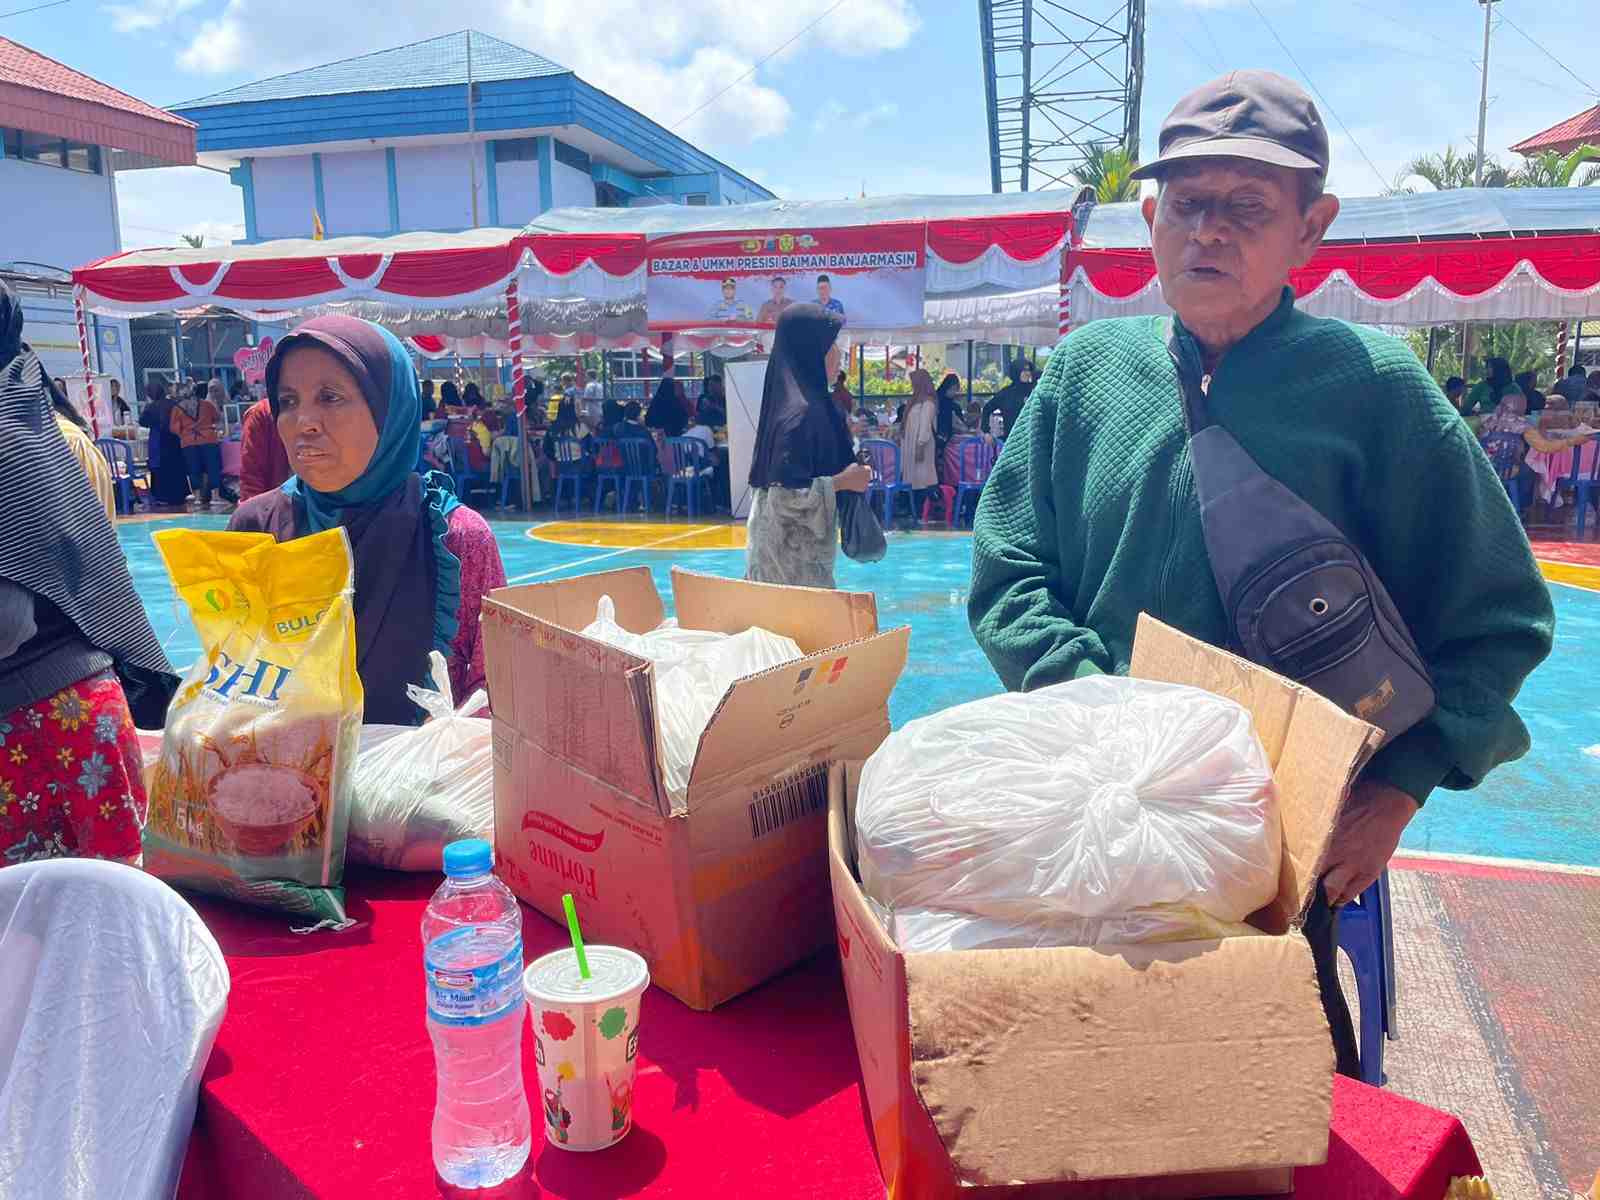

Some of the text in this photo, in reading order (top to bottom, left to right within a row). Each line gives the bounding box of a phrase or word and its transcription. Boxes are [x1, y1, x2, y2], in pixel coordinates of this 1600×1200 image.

[653, 252, 915, 271] BAZAR & UMKM PRESISI BAIMAN BANJARMASIN
[529, 840, 599, 901] Fortune
